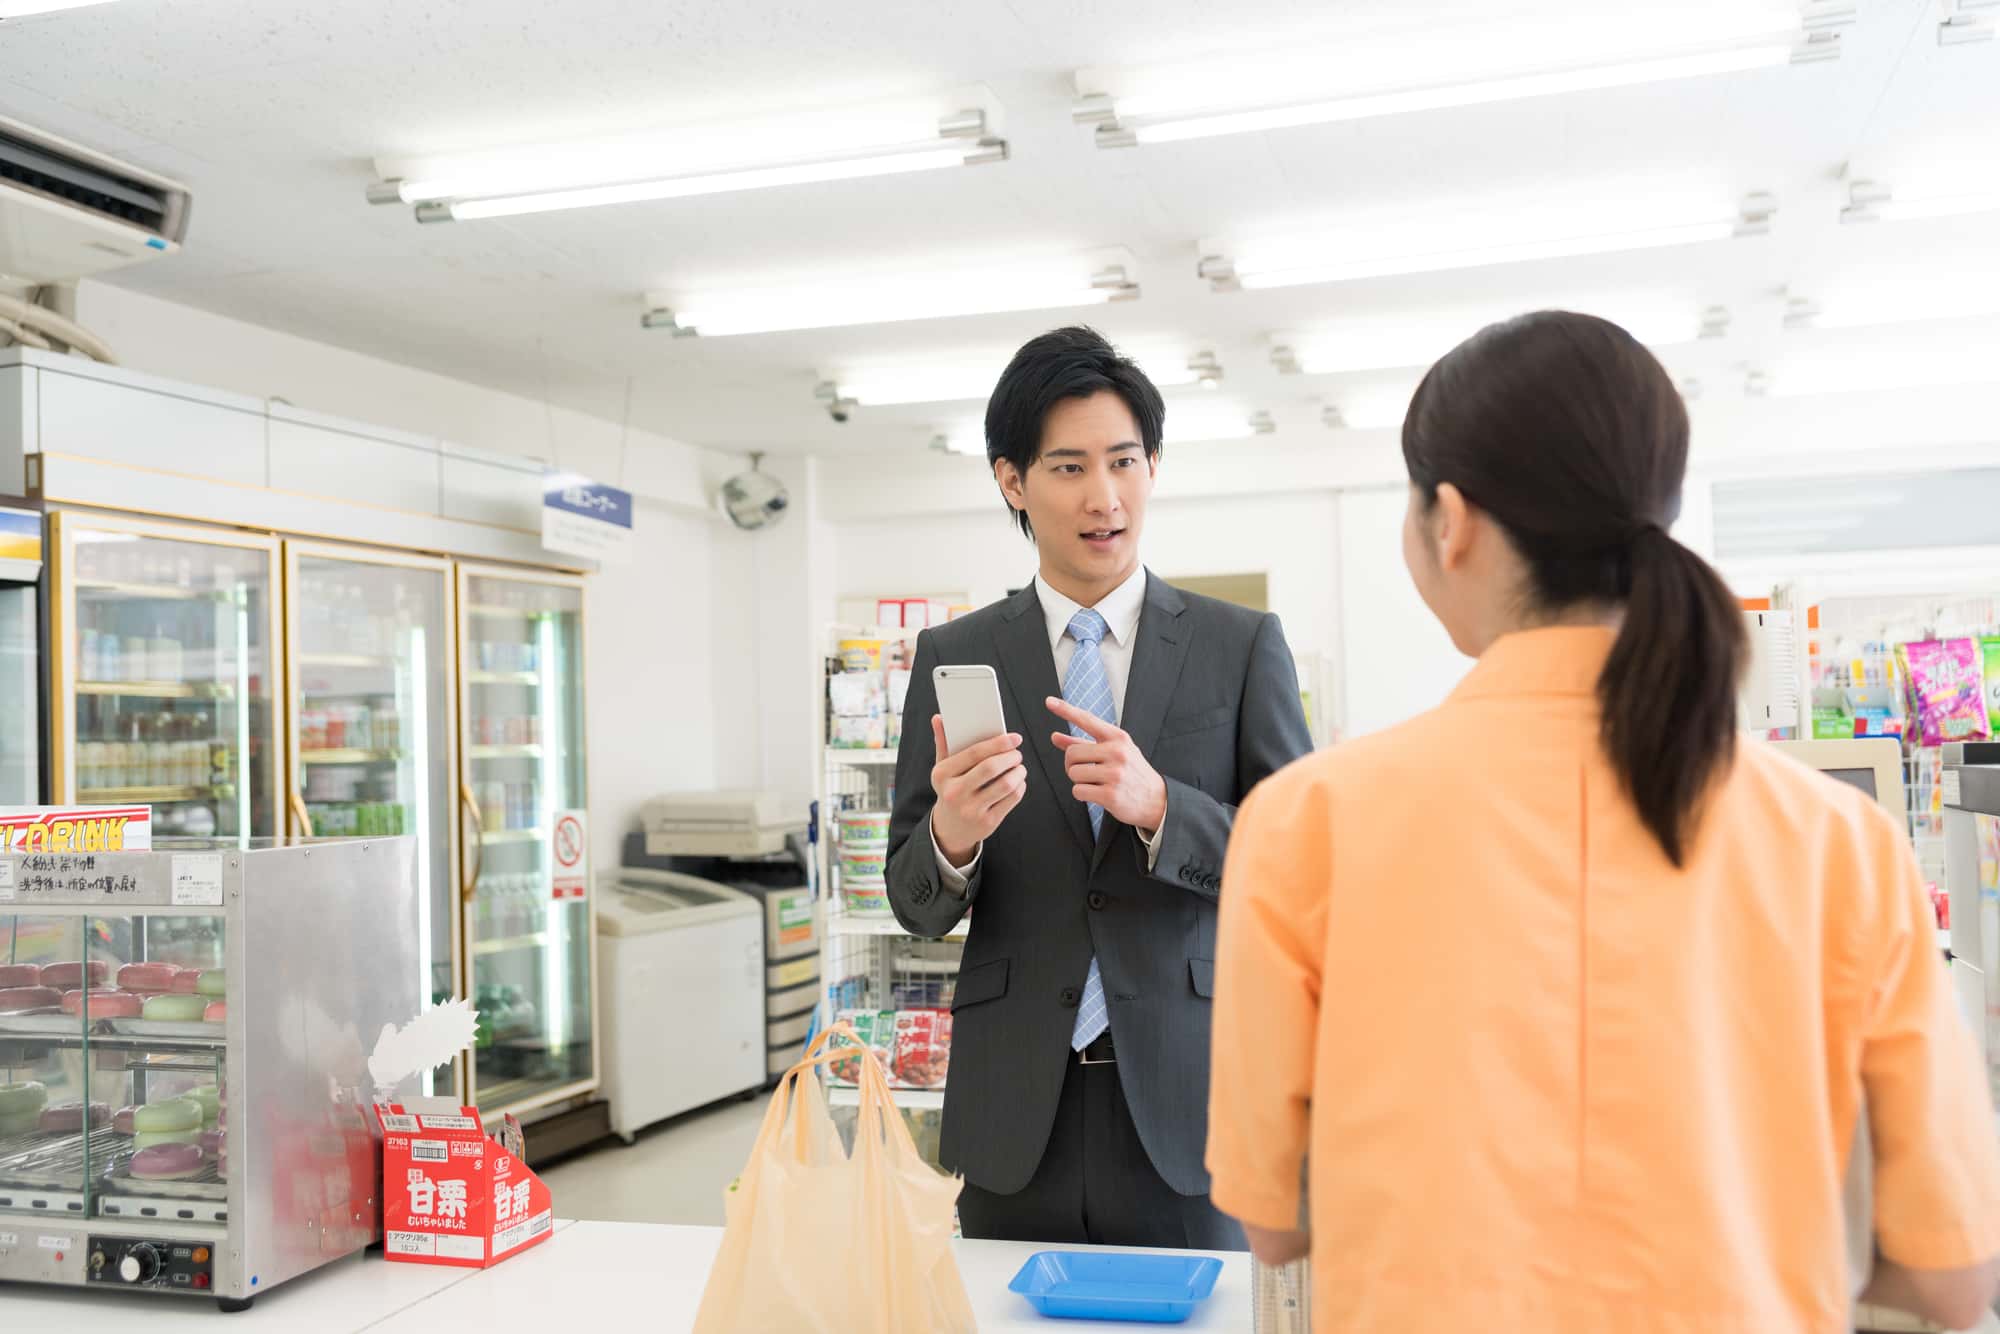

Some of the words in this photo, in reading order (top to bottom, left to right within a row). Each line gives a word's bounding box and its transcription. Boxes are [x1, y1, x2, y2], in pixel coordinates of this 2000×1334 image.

[25, 817, 129, 853] DRINK
[407, 1177, 468, 1218] 甘栗
[493, 1178, 531, 1221] 甘栗
[407, 1215, 467, 1230] むいちゃいました
